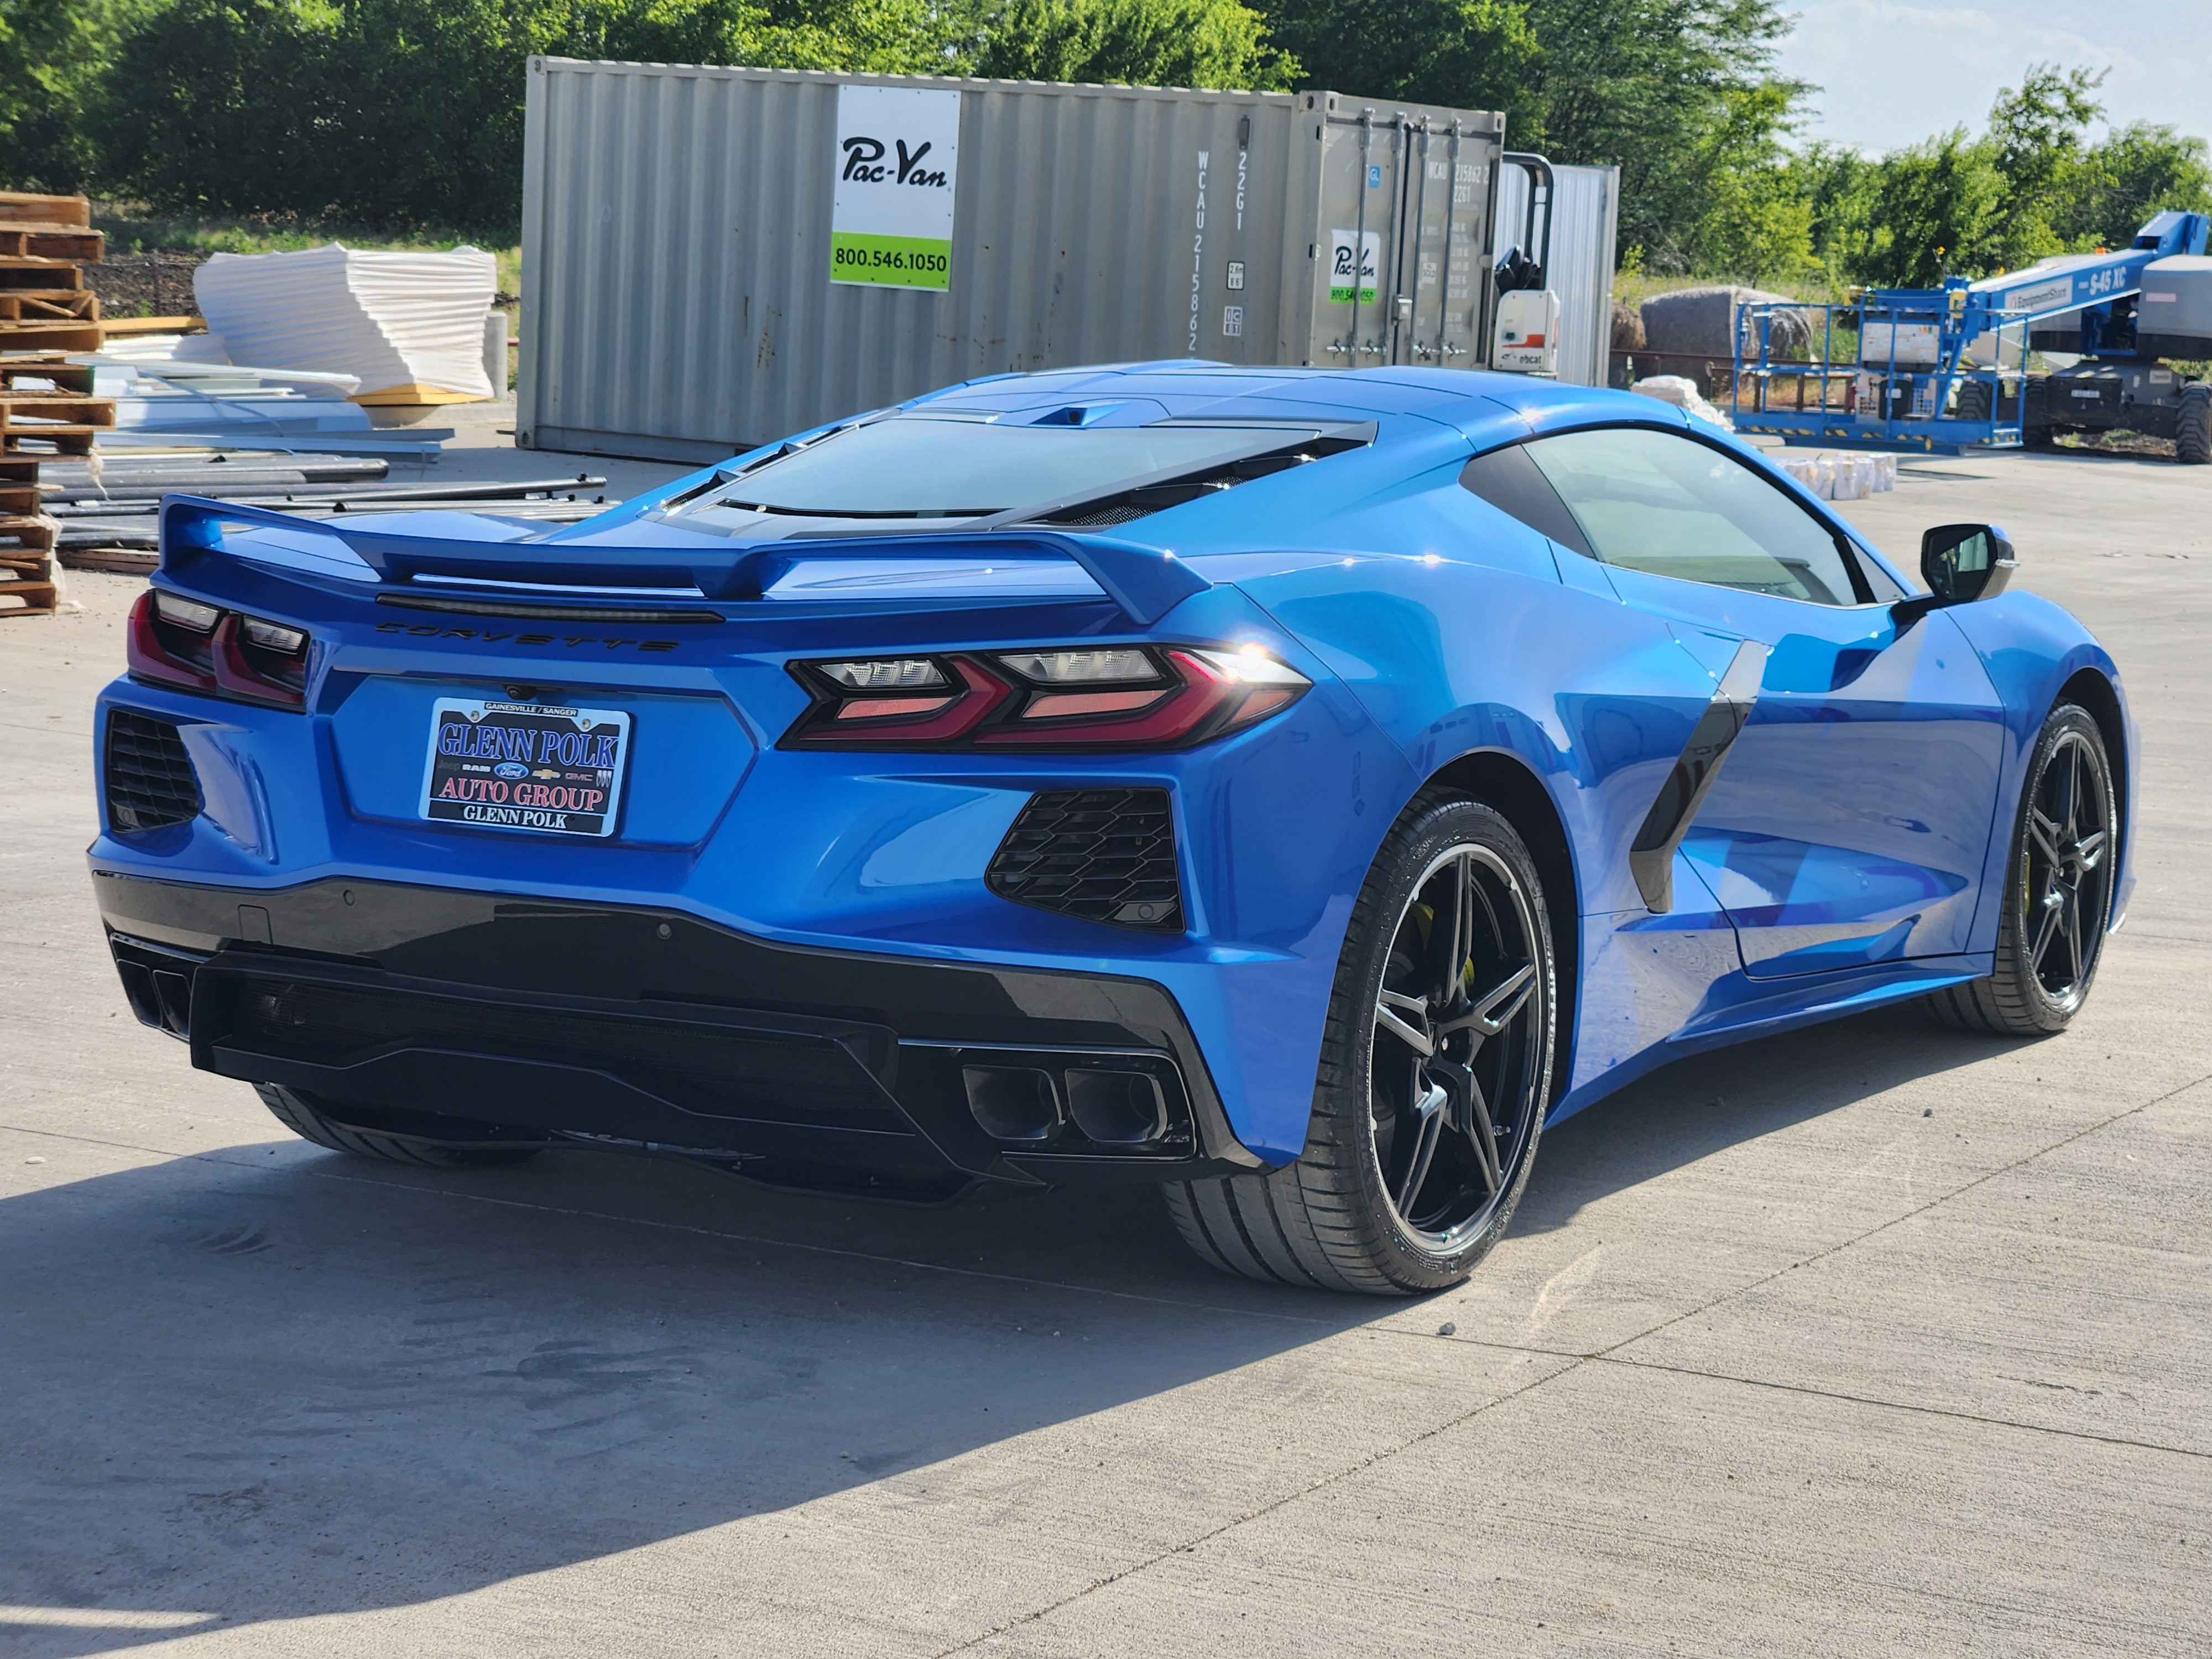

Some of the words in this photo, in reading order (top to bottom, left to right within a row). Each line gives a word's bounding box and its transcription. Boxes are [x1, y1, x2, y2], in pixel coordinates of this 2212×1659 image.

[842, 137, 947, 187] Pac-Van
[1428, 161, 1447, 180] WCAU
[1455, 164, 1481, 184] 215862
[1483, 165, 1489, 185] 2
[1196, 151, 1209, 229] WCAU
[1236, 152, 1246, 230] 22G1
[836, 248, 947, 272] 800.546.1050
[1188, 234, 1202, 351] 215862
[2089, 269, 2112, 296] S-45
[2112, 265, 2127, 289] XC
[2017, 287, 2067, 309] EquipmentShare
[374, 621, 682, 653] CORVETTE
[486, 703, 536, 713] GAINESVILLE
[543, 707, 577, 717] SANGER
[438, 723, 536, 762] GLENN
[538, 731, 619, 769] POLK
[462, 764, 491, 773] RAM
[565, 773, 593, 781] GMC
[439, 777, 509, 803] AUTO
[514, 782, 603, 811] GROUP
[463, 805, 521, 825] GLENN
[521, 812, 569, 829] POLK
[1357, 1050, 1371, 1169] MICHELIN
